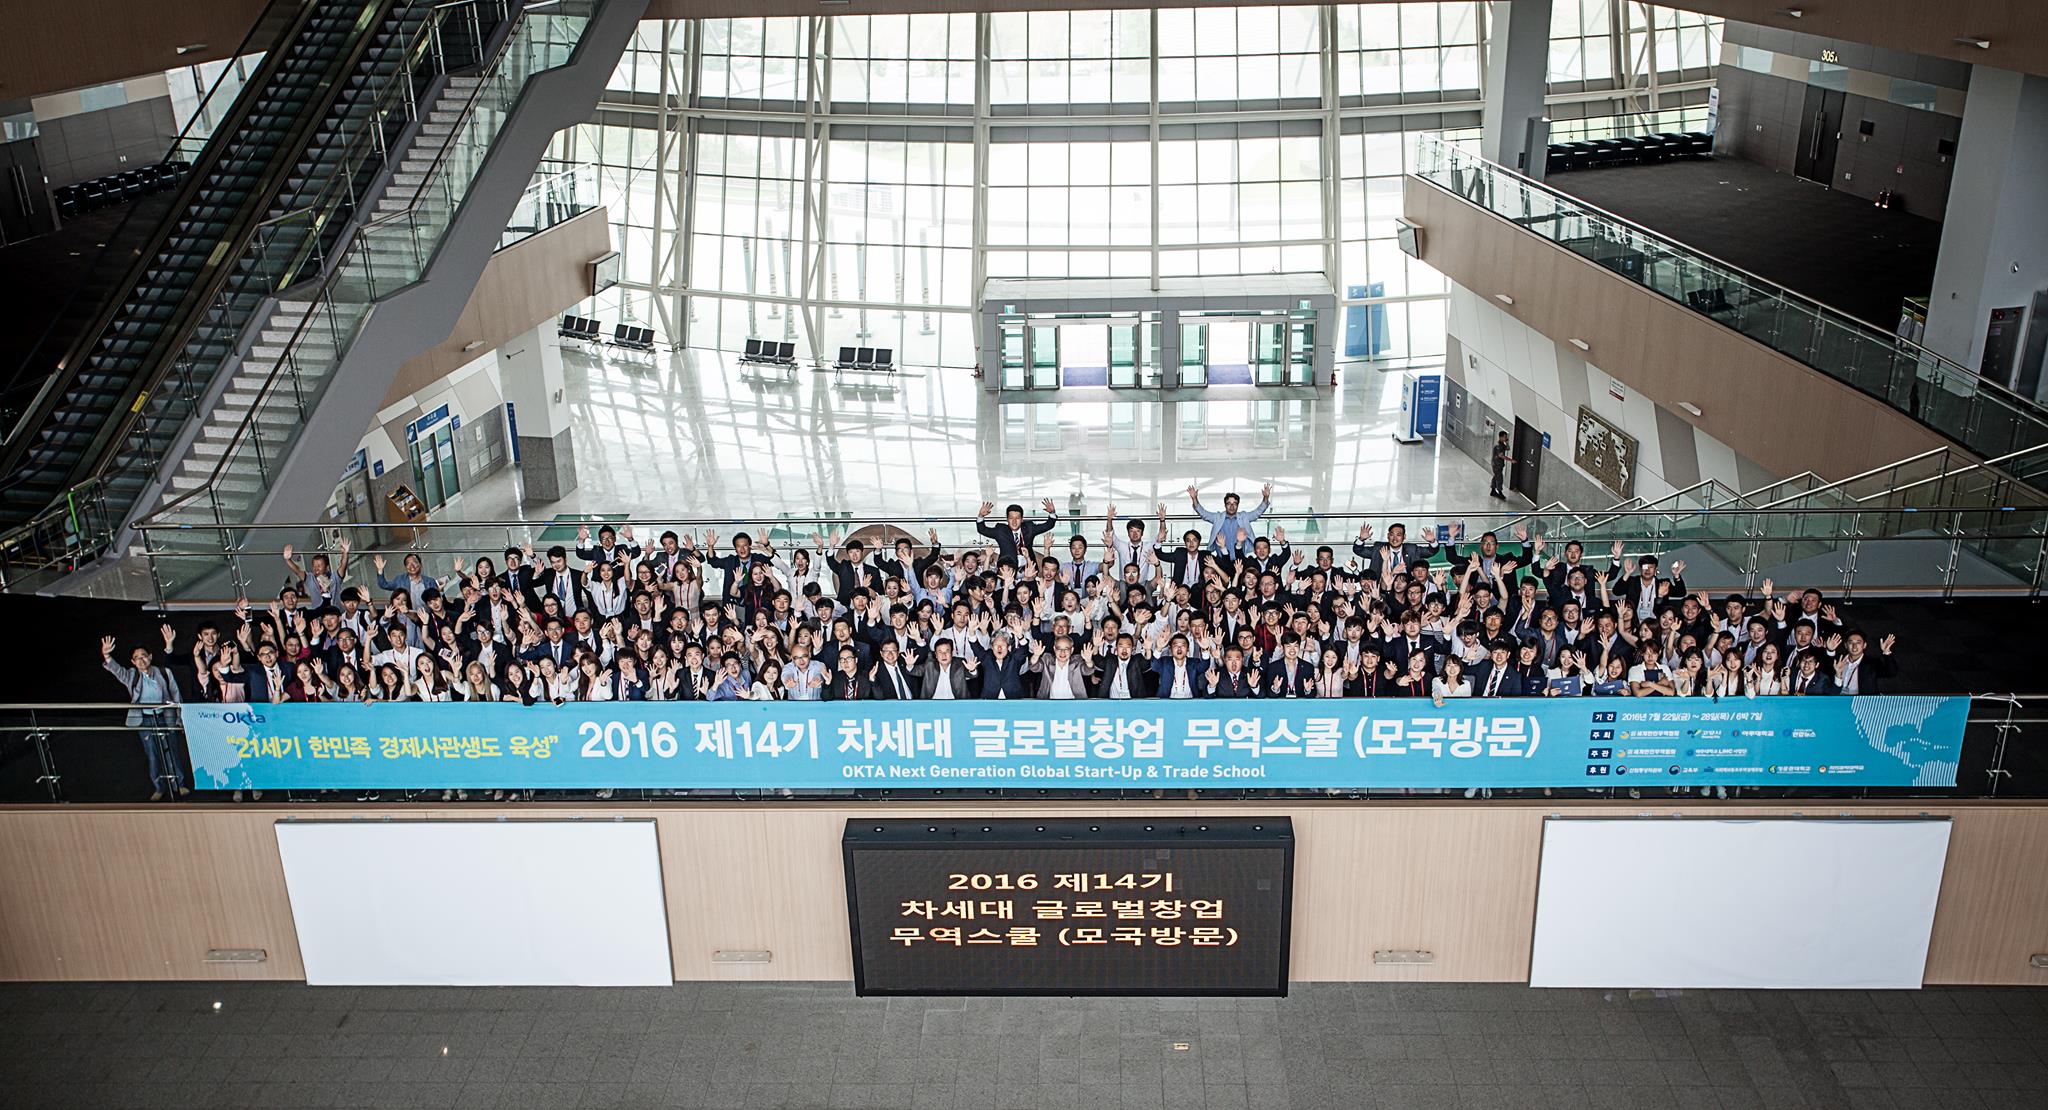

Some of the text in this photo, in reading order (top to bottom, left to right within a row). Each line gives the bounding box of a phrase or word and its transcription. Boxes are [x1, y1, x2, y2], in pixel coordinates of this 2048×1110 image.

[223, 711, 266, 726] Okta
[1622, 712, 1647, 721] 2016년
[1648, 712, 1661, 721] 7월
[579, 715, 1541, 759] 2016 제14기 차세대 글로벌창업 무역스쿨 (모국방문)
[309, 737, 371, 759] 한민족
[381, 737, 502, 759] 경제사관생도
[842, 764, 1266, 781] OKTA Next Generation Global Start-Up & Trade School
[948, 872, 1174, 893] 2016 제14기
[901, 899, 1224, 920] 차세대 글로벌창업
[889, 926, 1239, 947] 무역스쿨 (모국방문)
